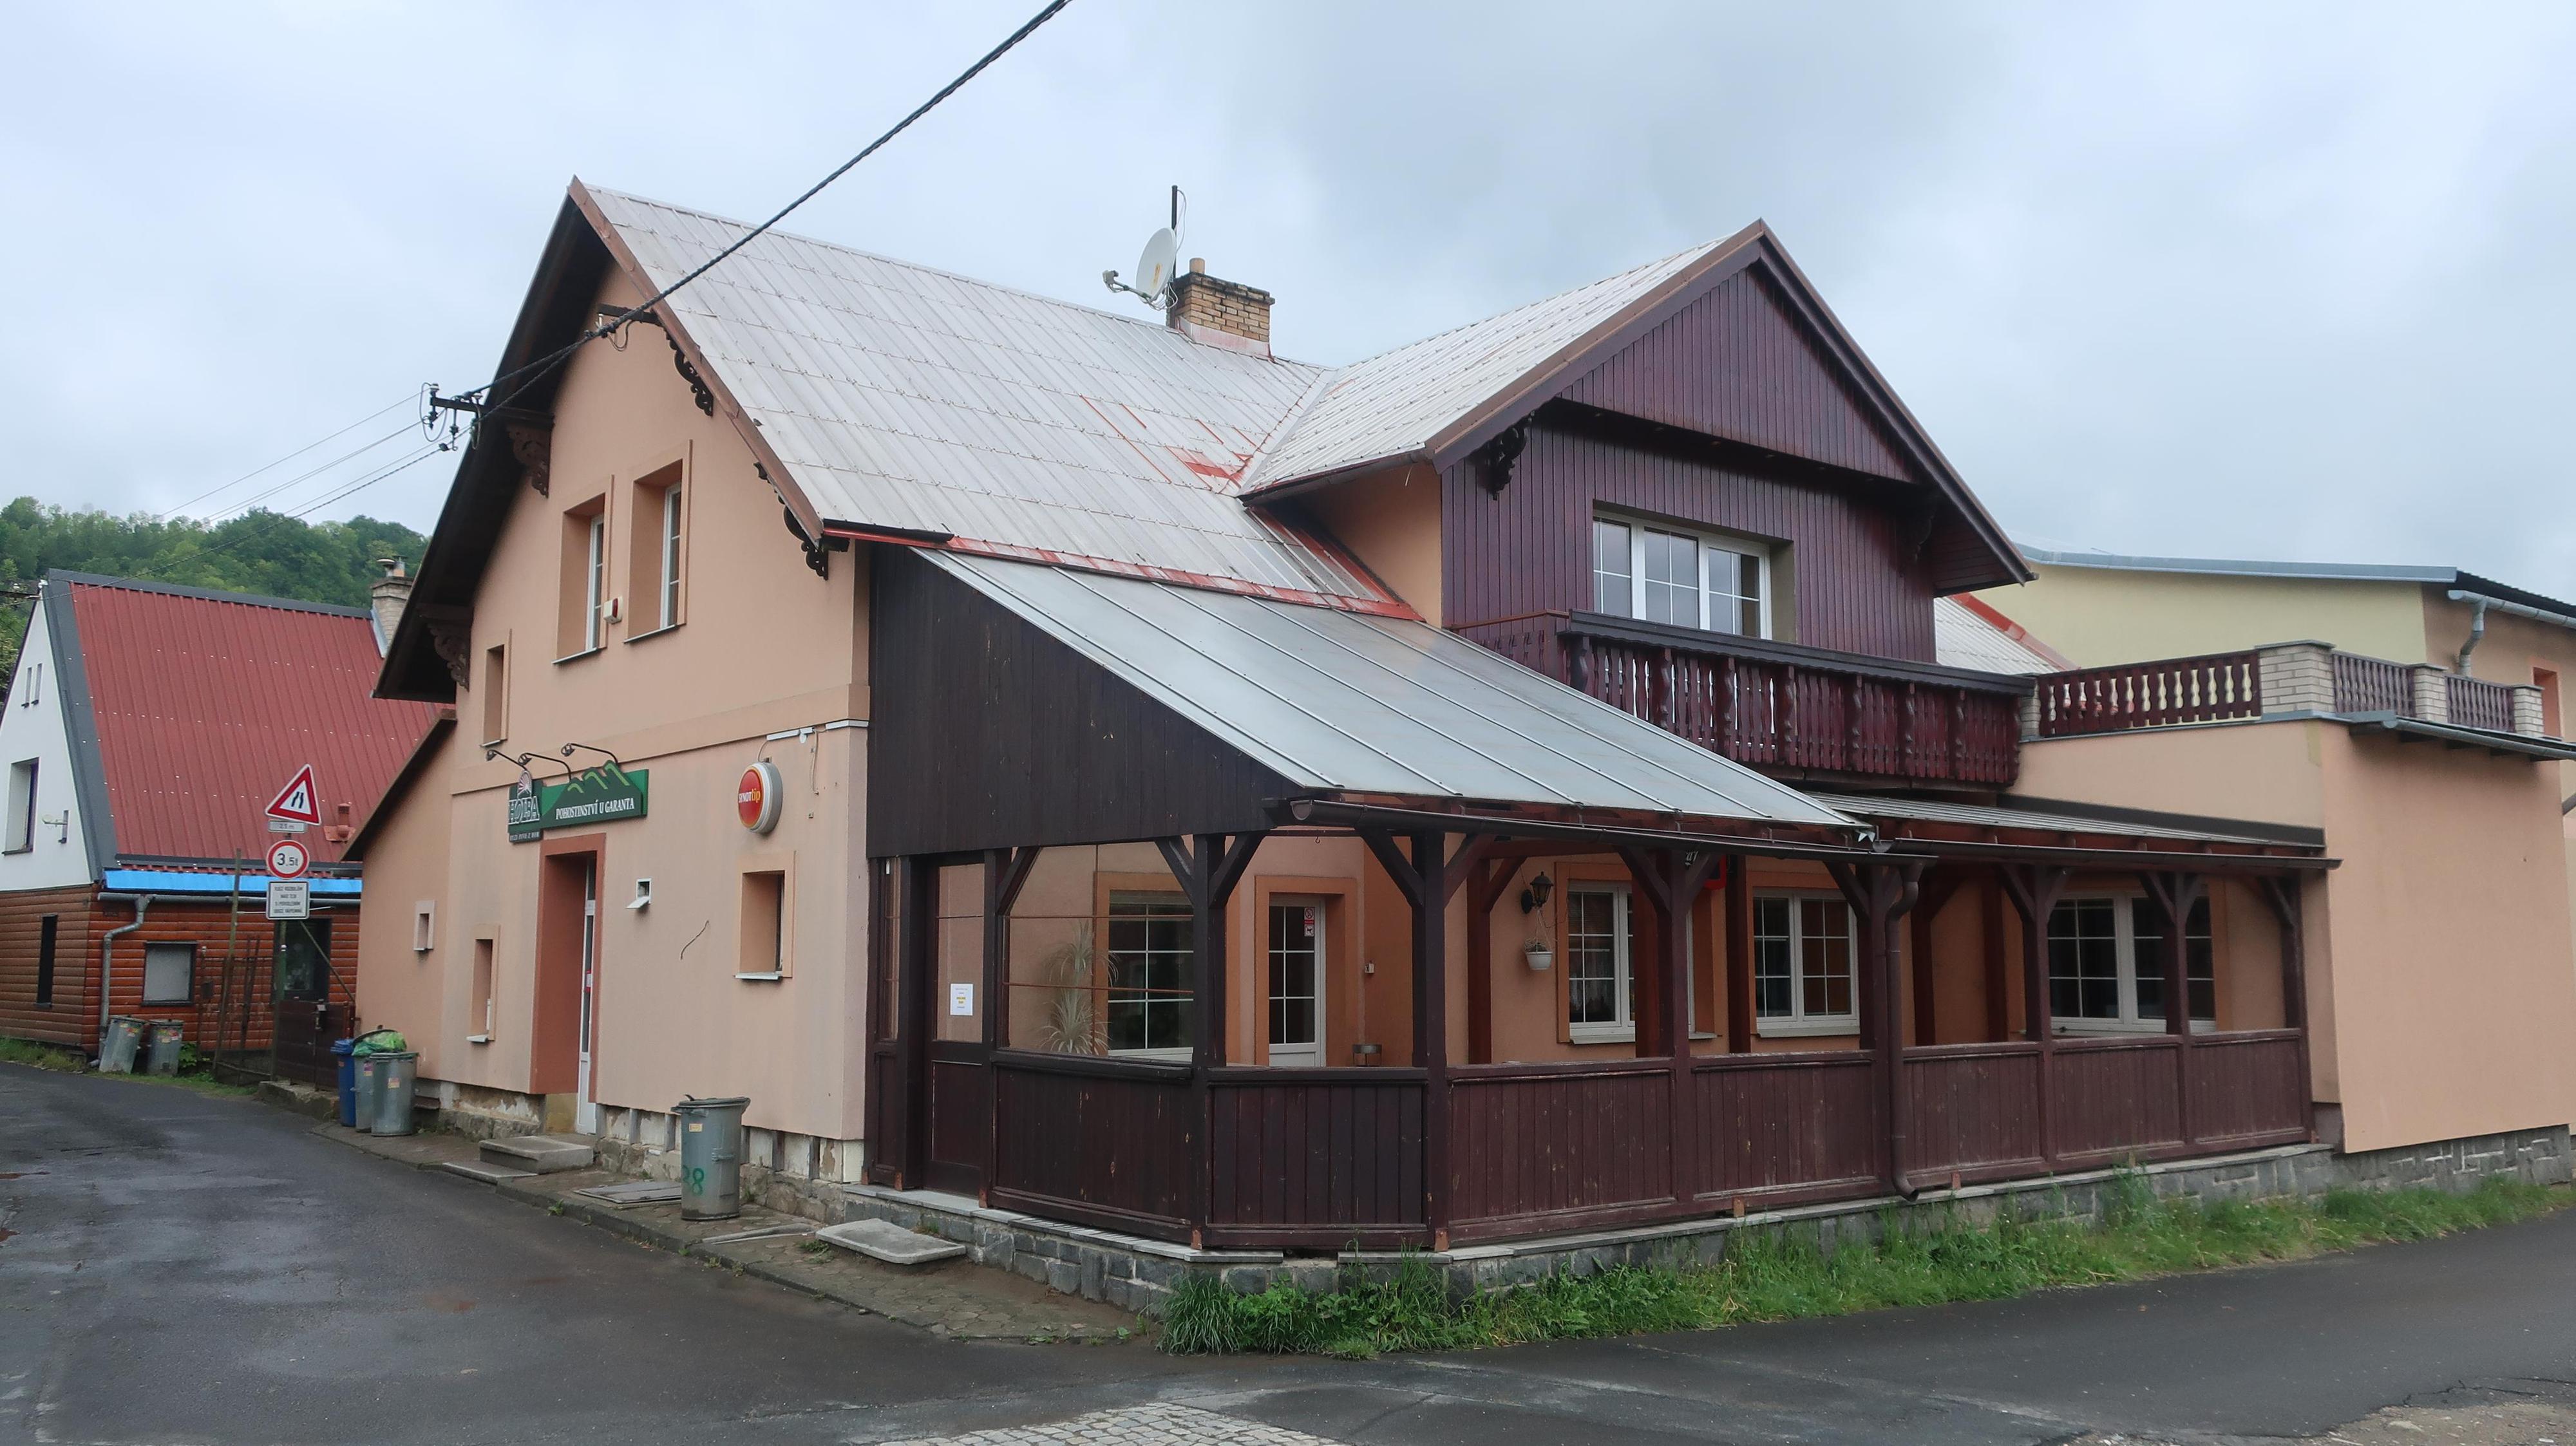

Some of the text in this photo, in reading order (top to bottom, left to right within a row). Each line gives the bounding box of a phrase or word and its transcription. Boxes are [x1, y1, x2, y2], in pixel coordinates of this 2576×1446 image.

[555, 798, 635, 820] POHOSTINSTVÍ U GARANTA
